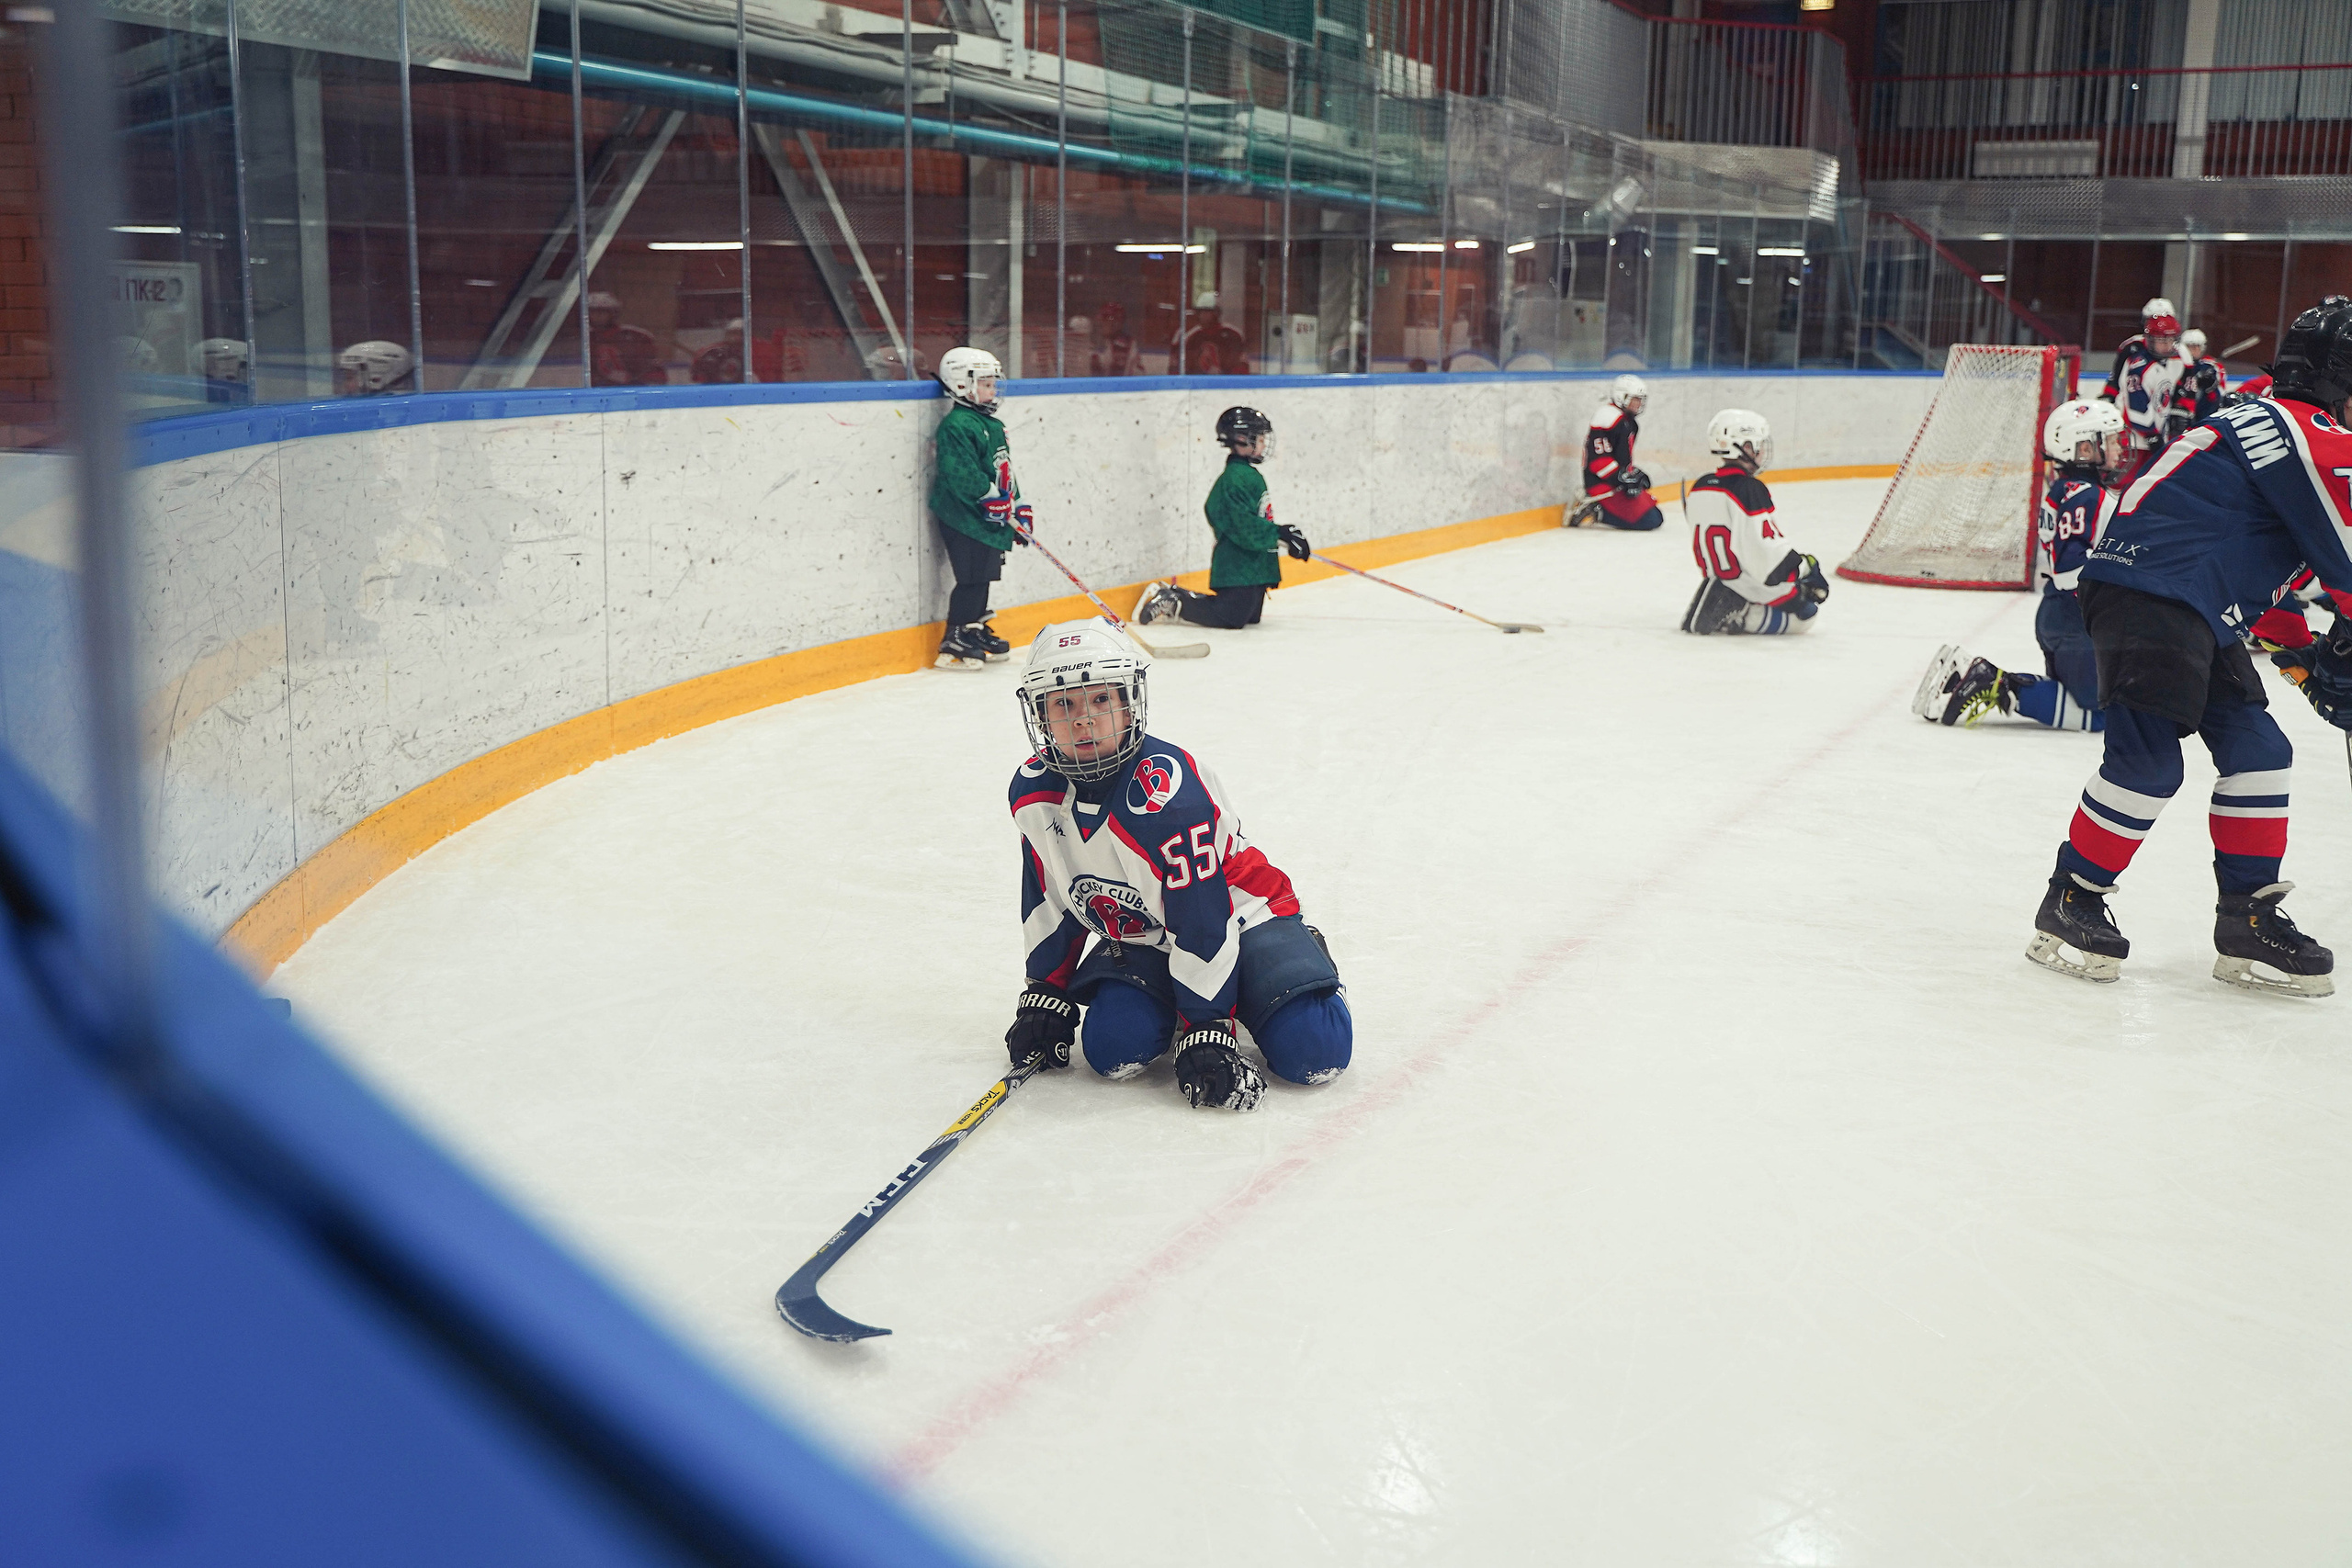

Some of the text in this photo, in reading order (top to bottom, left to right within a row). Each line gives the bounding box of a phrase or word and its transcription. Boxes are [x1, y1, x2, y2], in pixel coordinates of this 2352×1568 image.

[2210, 402, 2291, 470] СКИЙ
[2058, 506, 2086, 540] 83
[2098, 537, 2141, 557] ETIX
[1058, 635, 1081, 648] 55
[1051, 661, 1092, 674] BAUER
[1159, 821, 1219, 890] 55
[1108, 887, 1144, 909] CLUB
[1019, 993, 1071, 1018] RRIOR
[970, 1089, 1001, 1113] TACKS
